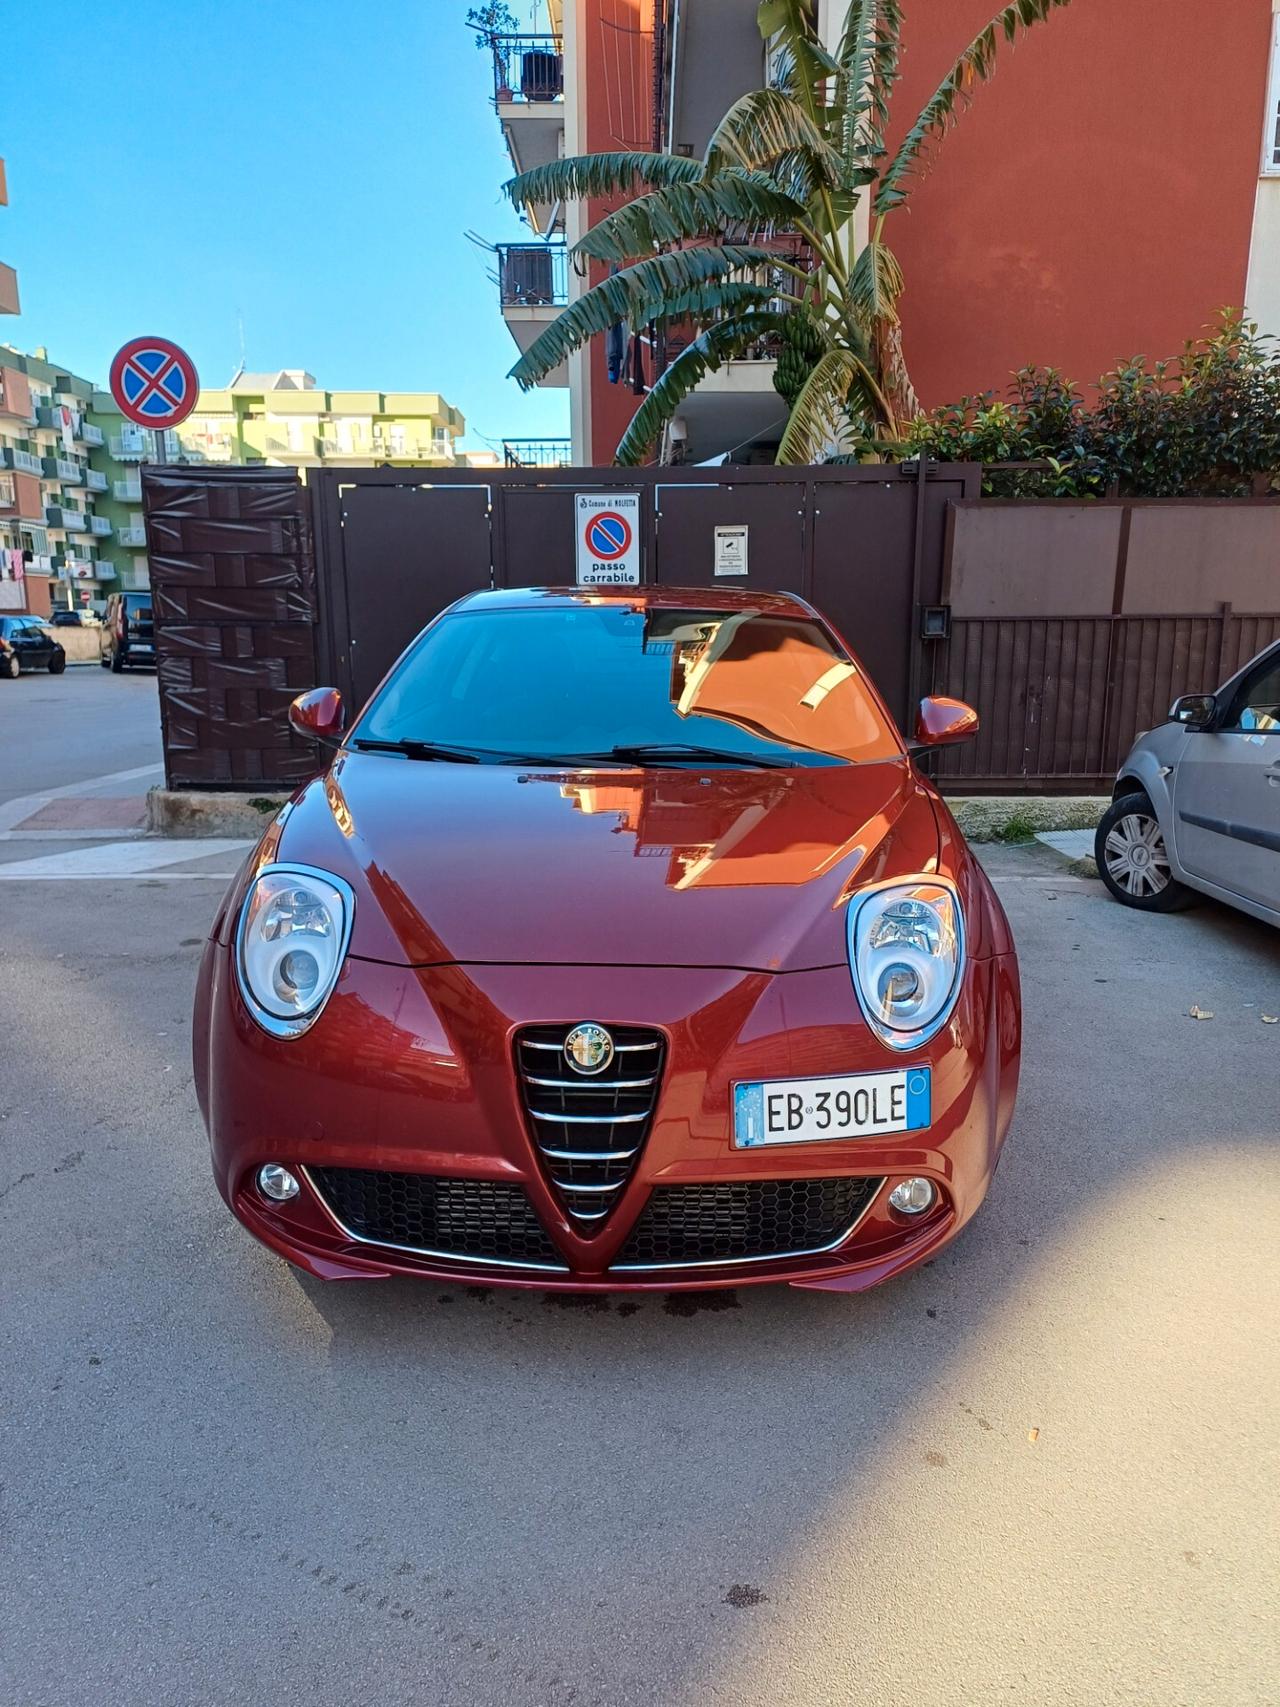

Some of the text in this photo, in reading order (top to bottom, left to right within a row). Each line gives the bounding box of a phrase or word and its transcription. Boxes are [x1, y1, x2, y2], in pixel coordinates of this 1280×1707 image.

[608, 499, 612, 507] di
[592, 563, 626, 572] passo
[583, 573, 635, 582] carrabile
[567, 1028, 610, 1051] ALFA ROMEO
